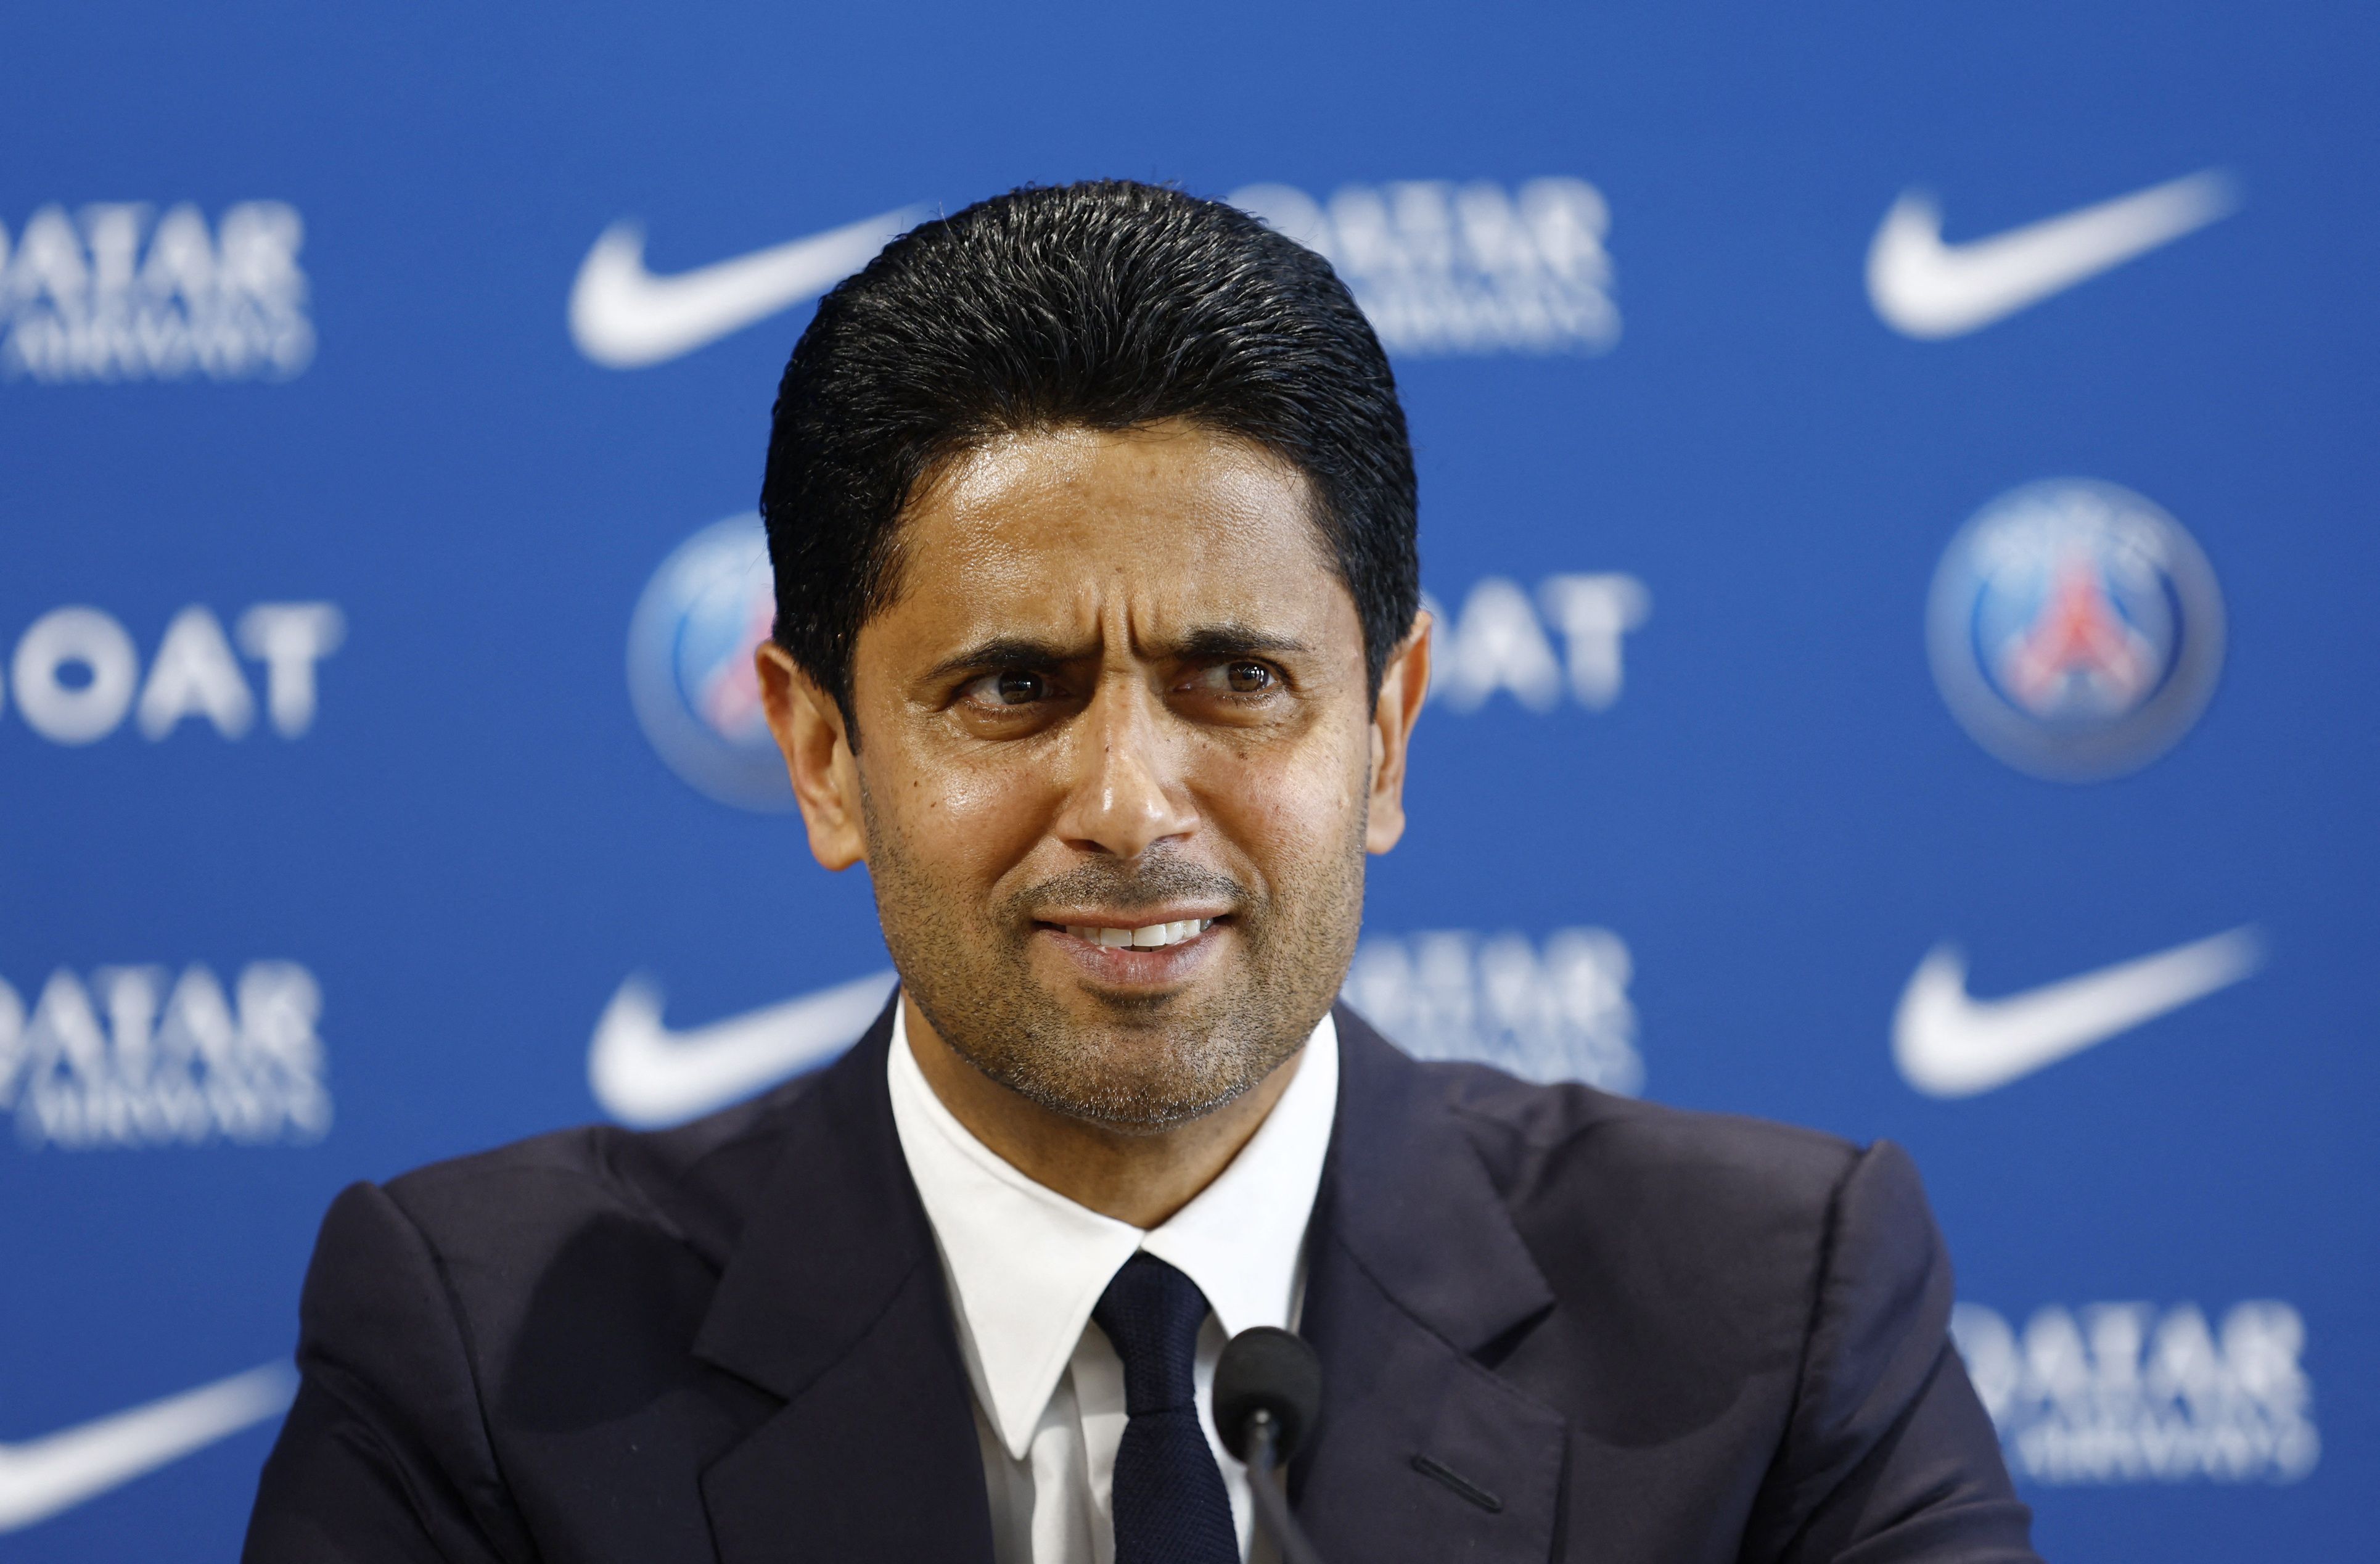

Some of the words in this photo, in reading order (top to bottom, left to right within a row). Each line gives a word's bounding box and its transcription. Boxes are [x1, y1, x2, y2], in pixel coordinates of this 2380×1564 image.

[0, 199, 312, 319] ATAR
[0, 601, 347, 747] OAT
[1420, 571, 1652, 714] AT
[1342, 925, 1637, 1048] ATAR
